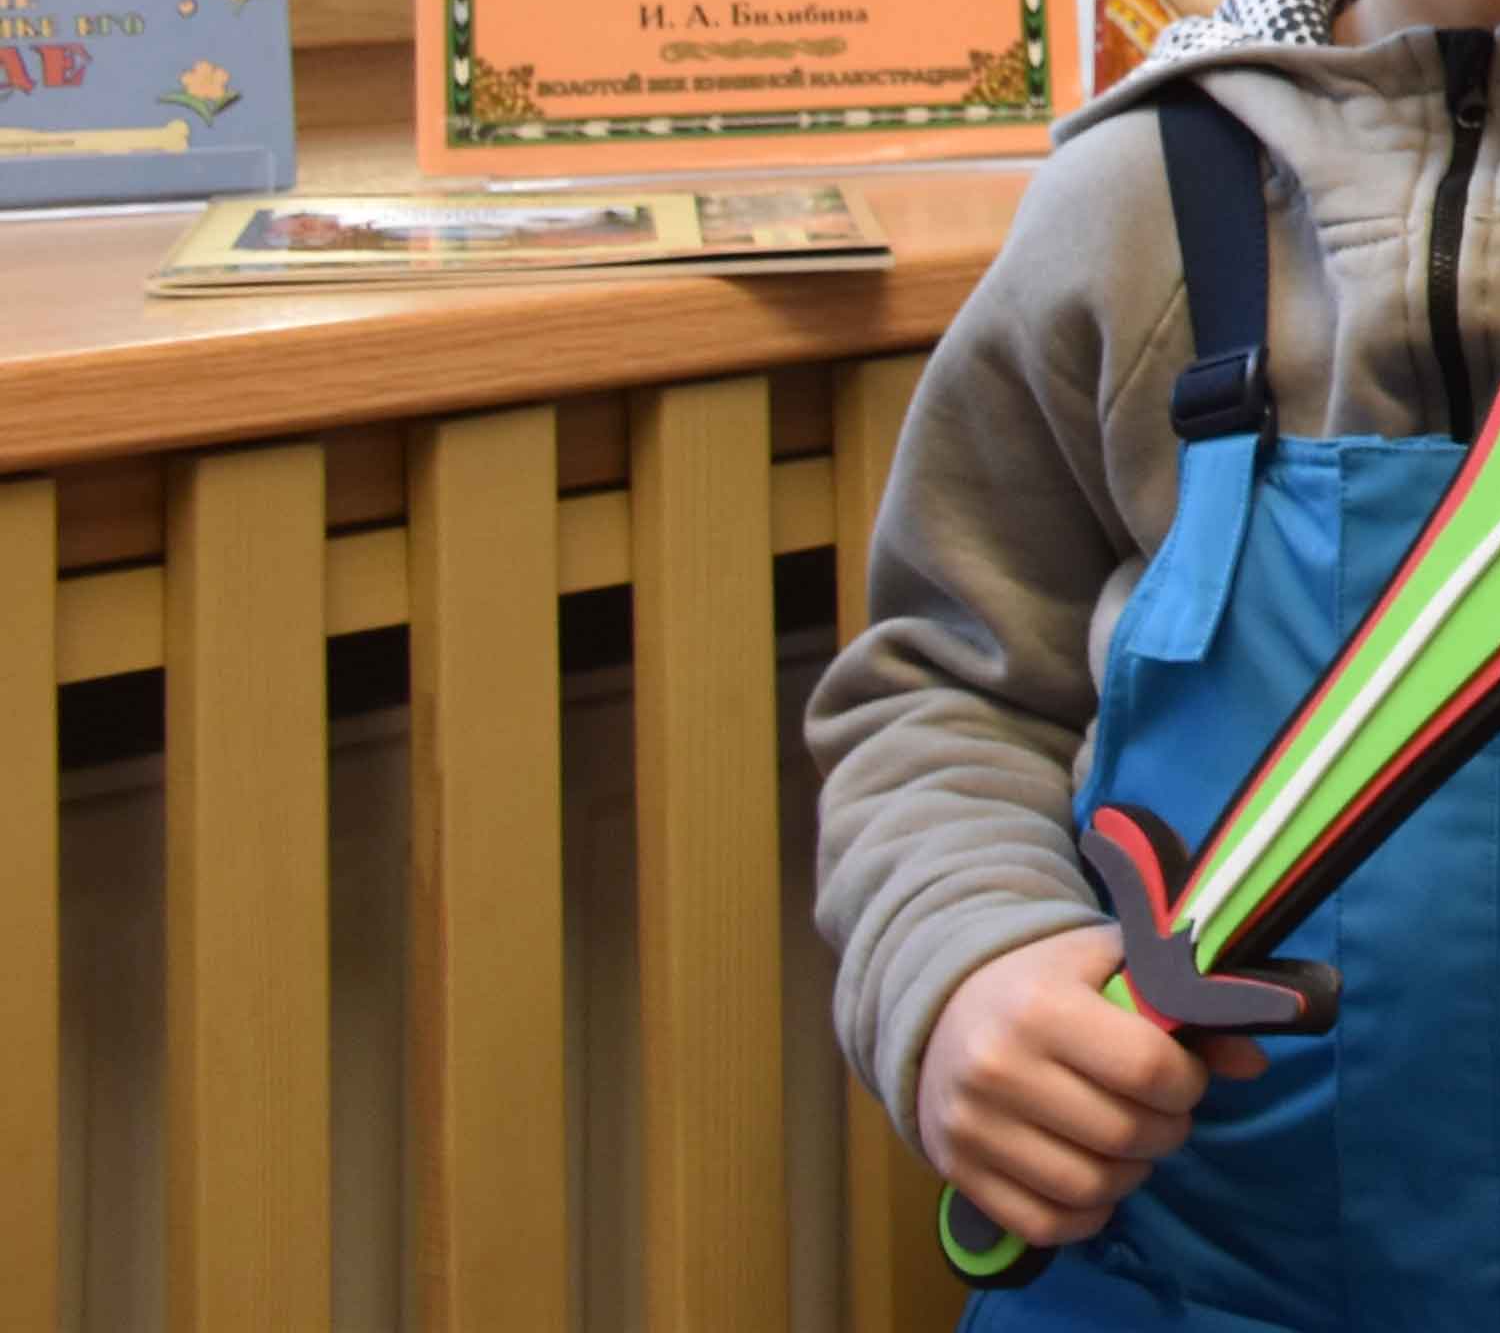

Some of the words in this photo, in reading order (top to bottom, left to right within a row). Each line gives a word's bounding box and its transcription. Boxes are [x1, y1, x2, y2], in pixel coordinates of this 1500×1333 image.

[638, 3, 676, 30] И.
[686, 3, 721, 29] А.
[730, 0, 869, 27] Билибина
